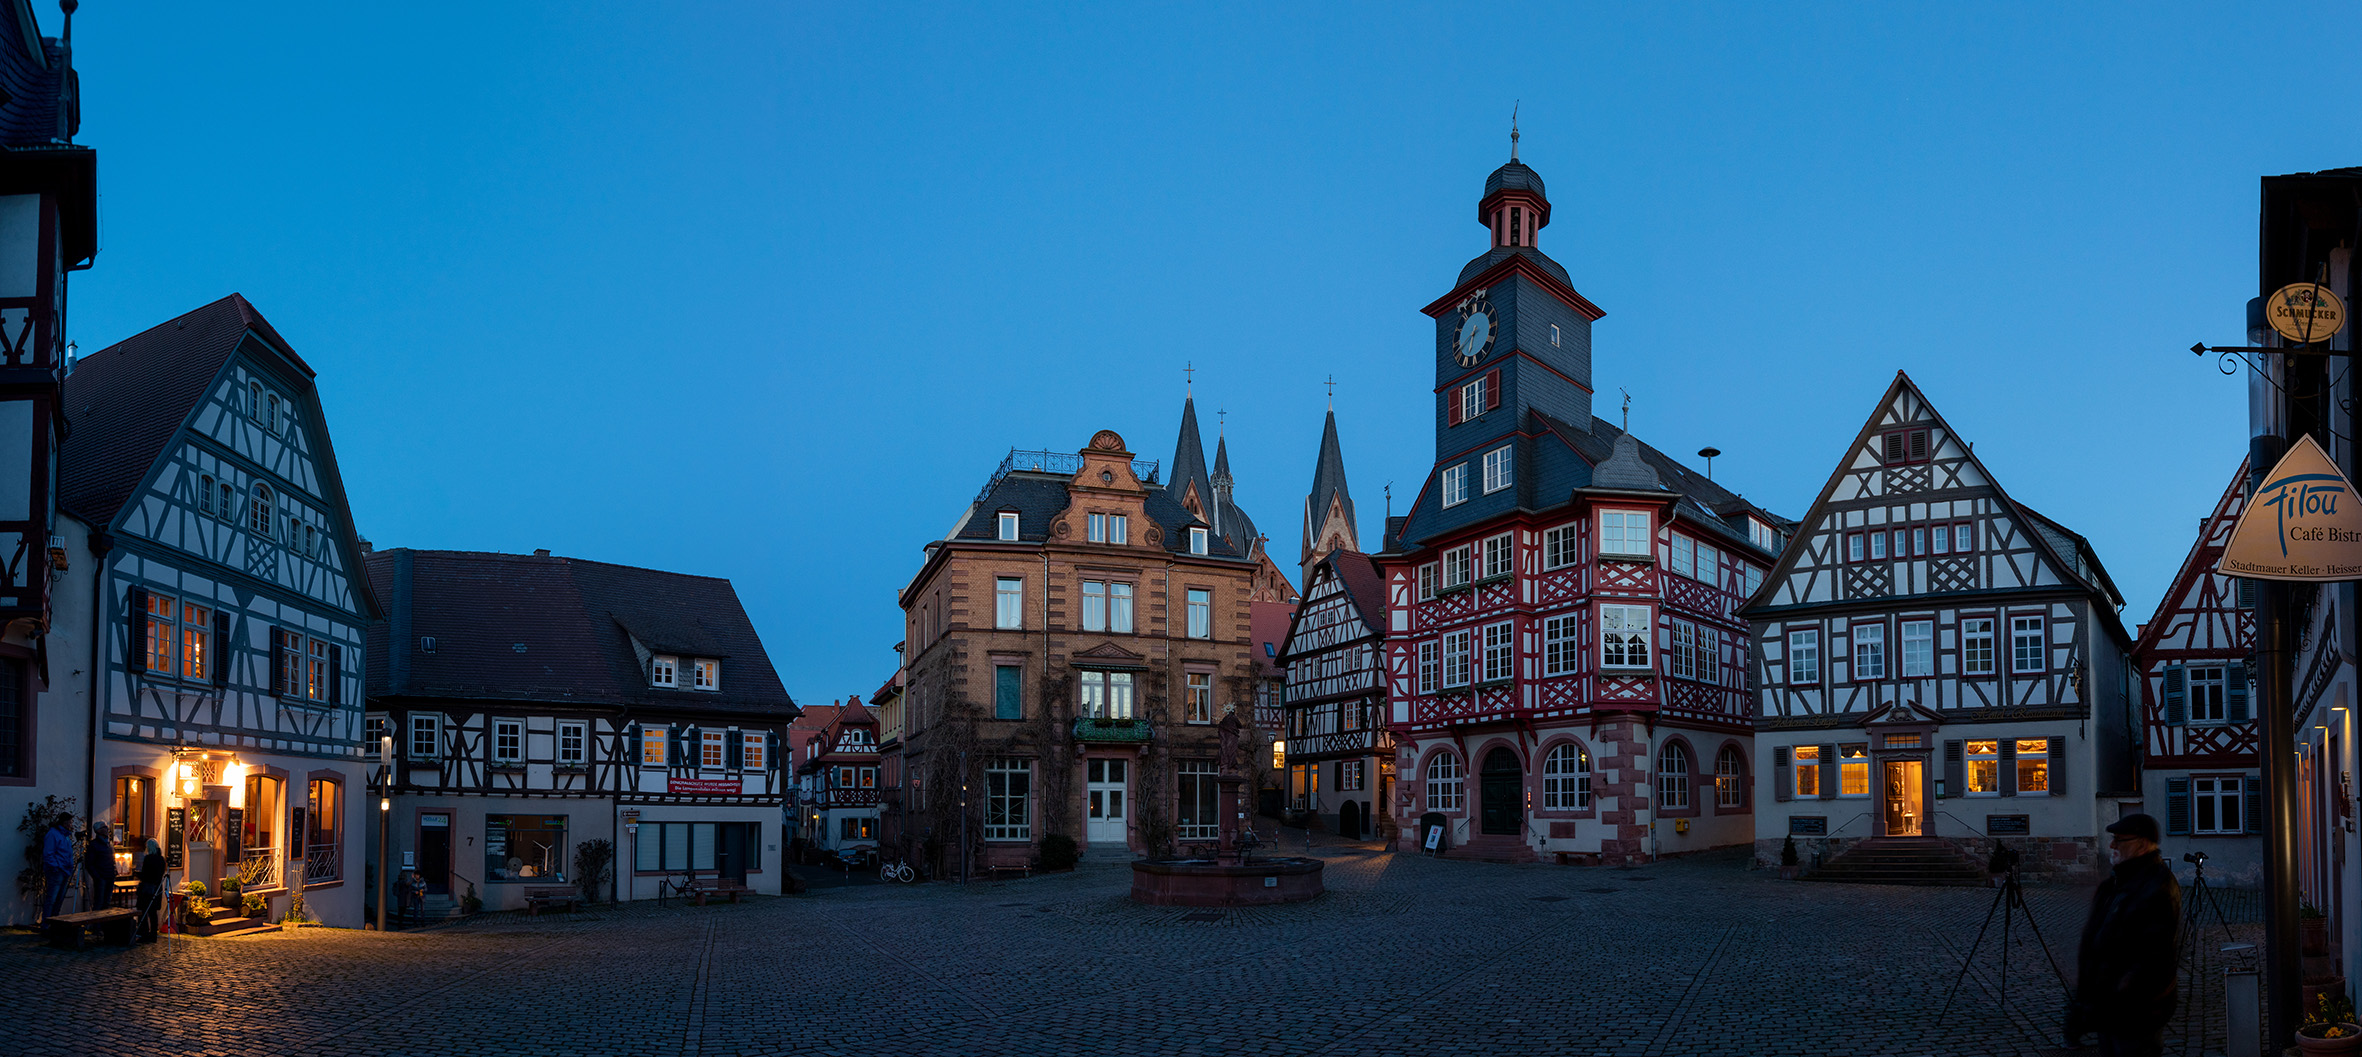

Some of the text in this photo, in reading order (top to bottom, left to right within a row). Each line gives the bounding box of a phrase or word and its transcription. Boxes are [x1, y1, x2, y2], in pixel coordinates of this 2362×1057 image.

[2276, 305, 2337, 320] SCHMUCKER
[2258, 473, 2345, 559] Filou
[2290, 526, 2362, 542] Café Bistr
[2230, 559, 2287, 574] Stadtmauer
[2290, 564, 2320, 575] Keller
[1970, 706, 2066, 721] Hotel Restaurant
[466, 836, 474, 847] 7
